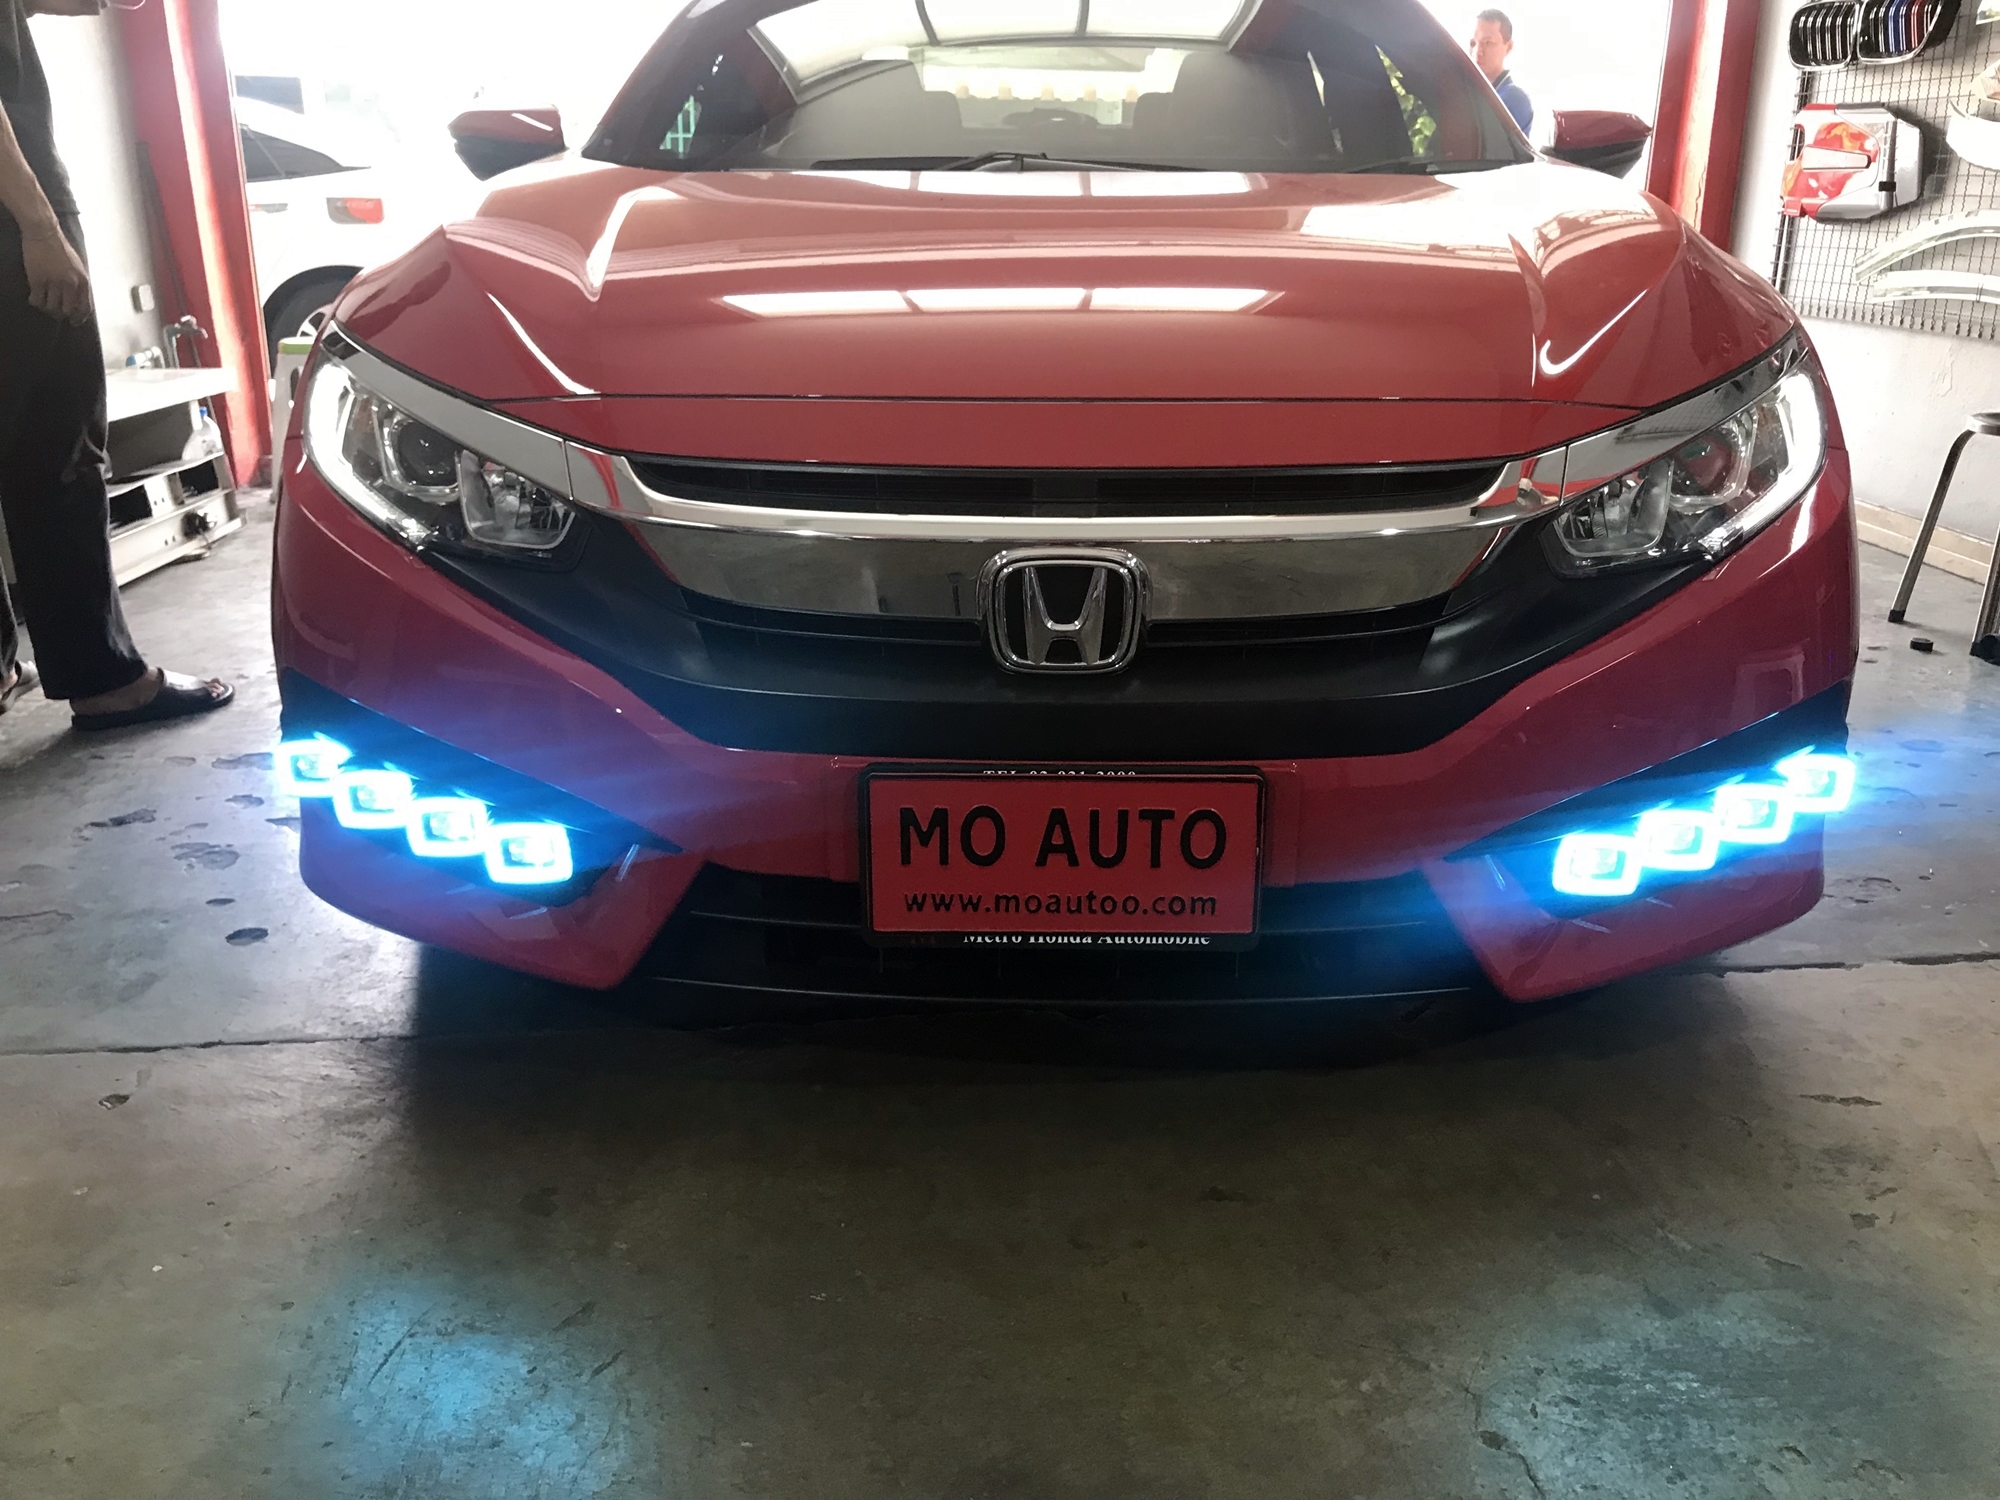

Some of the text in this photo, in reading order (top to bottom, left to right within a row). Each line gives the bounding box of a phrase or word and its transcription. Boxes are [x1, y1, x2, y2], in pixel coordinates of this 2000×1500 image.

[900, 805, 1227, 869] MO AUTO
[904, 890, 1217, 916] www.moautoo.com
